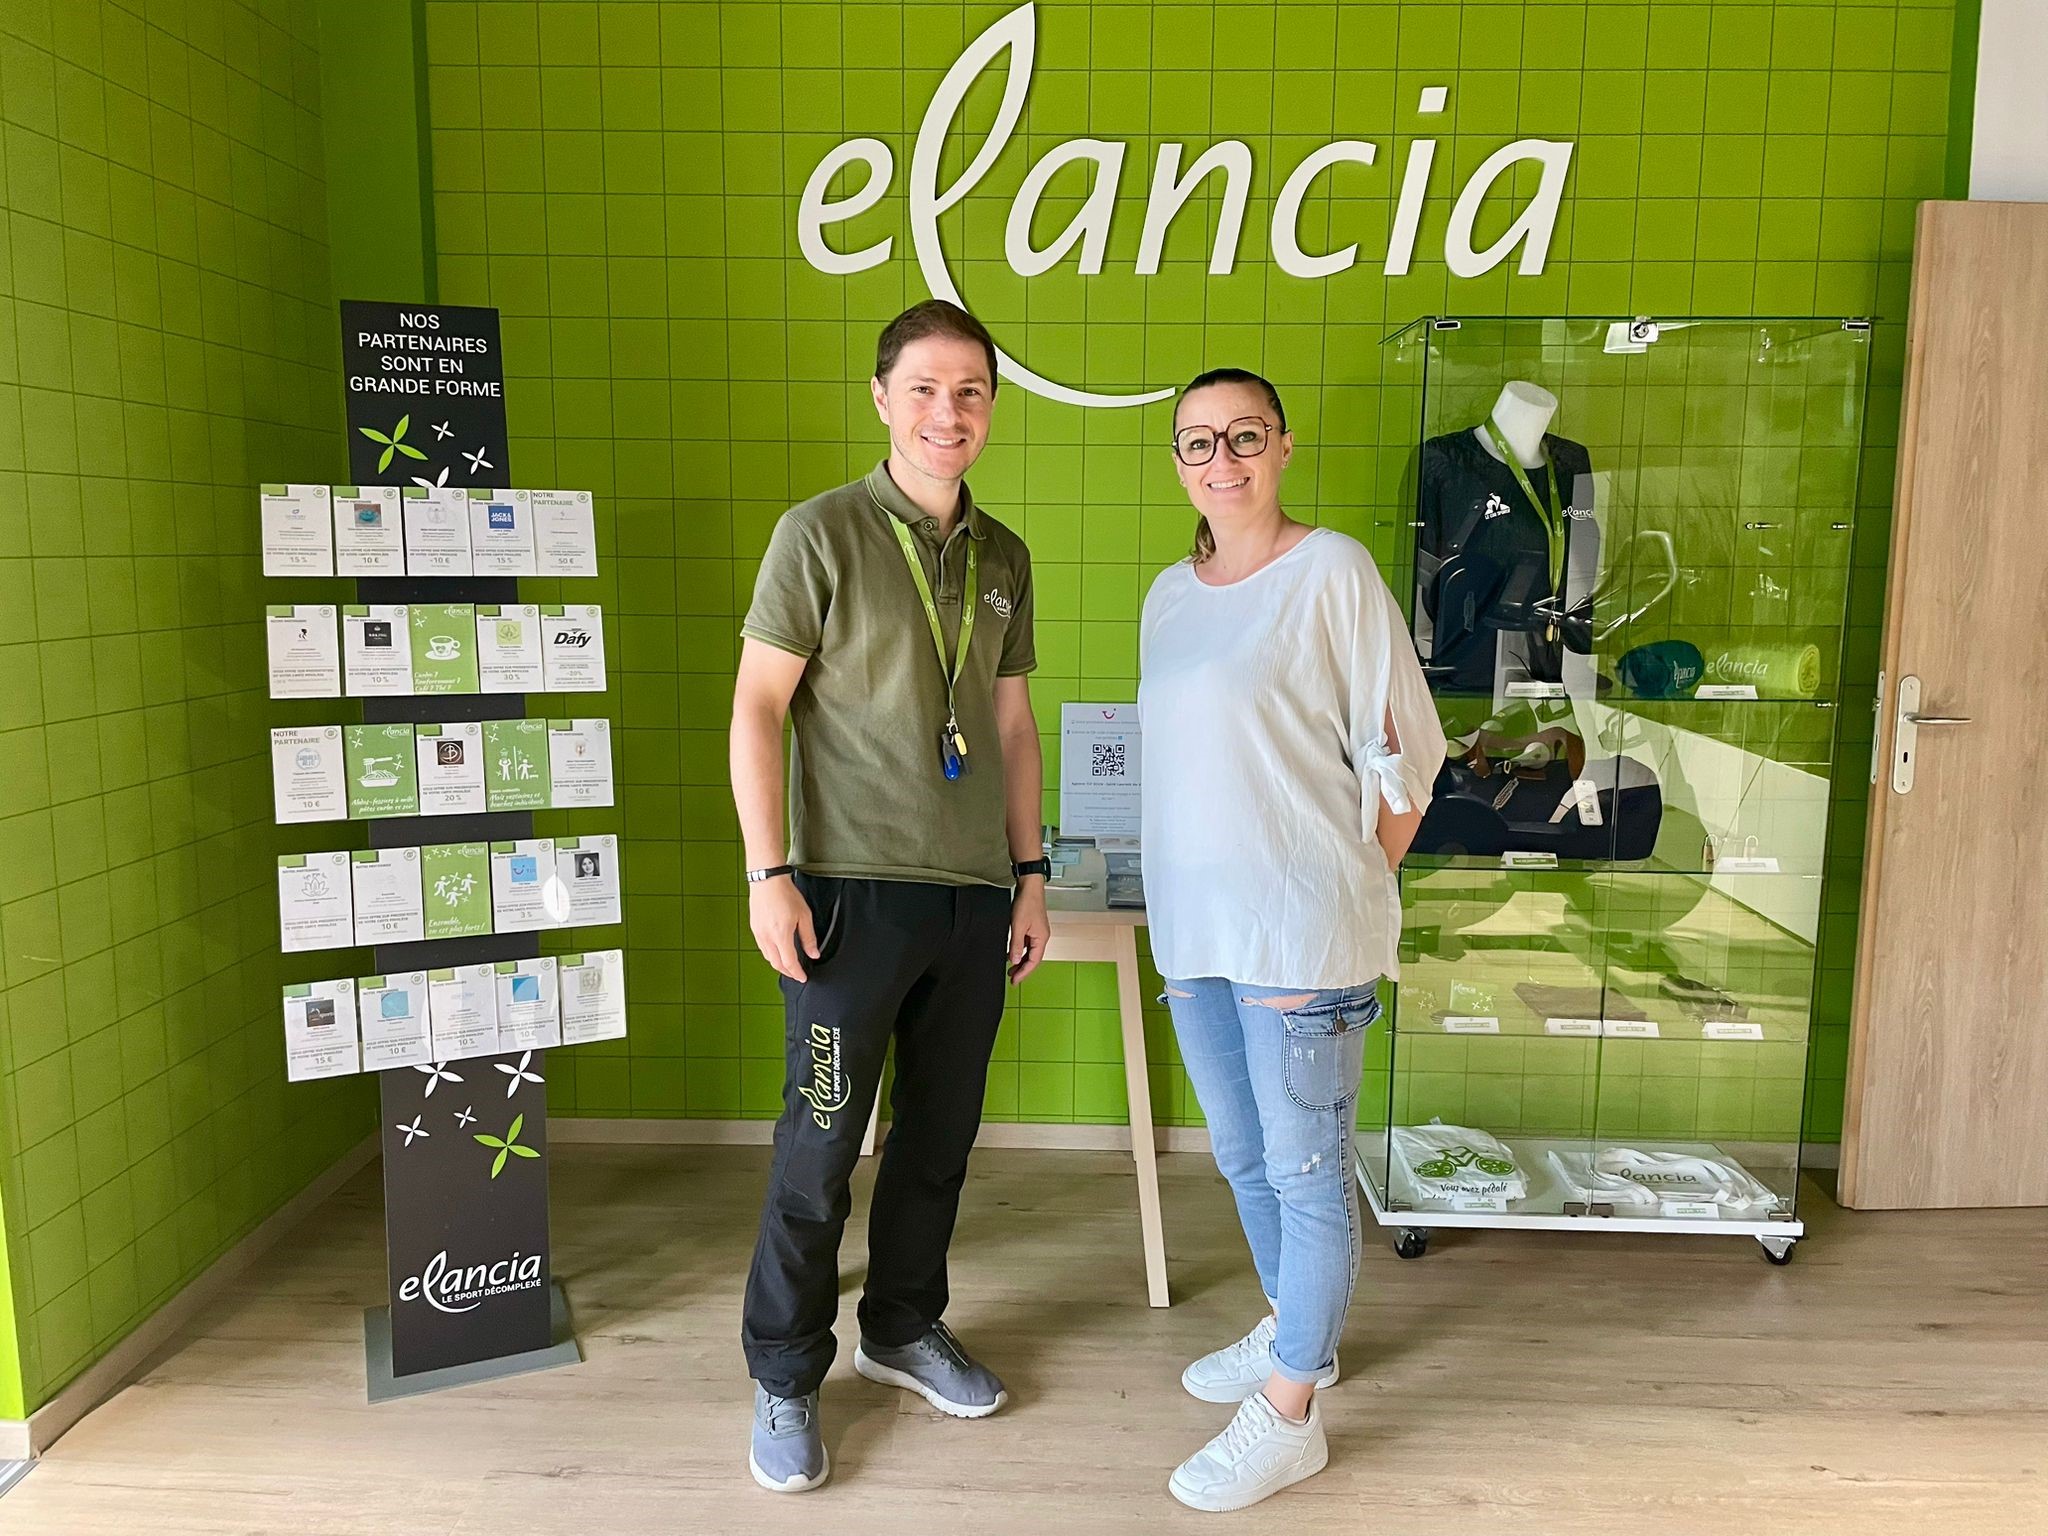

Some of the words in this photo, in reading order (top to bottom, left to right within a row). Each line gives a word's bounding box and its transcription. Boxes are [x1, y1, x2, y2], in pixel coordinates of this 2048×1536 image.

[798, 1, 1575, 408] elancia
[400, 313, 441, 330] NOS
[358, 332, 488, 354] PARTENAIRES
[381, 355, 433, 373] SONT
[438, 358, 464, 374] EN
[350, 376, 430, 395] GRANDE
[435, 380, 501, 398] FORME
[363, 556, 372, 564] 10
[983, 588, 1012, 619] elan
[553, 632, 592, 648] Dafy
[1706, 652, 1769, 683] elancia
[303, 800, 313, 808] 10
[382, 922, 392, 930] 10
[389, 1047, 399, 1055] 10
[798, 1023, 852, 1130] elancia
[1607, 1167, 1697, 1182] lancia
[1440, 1183, 1459, 1193] Vous
[399, 1250, 542, 1314] elancia
[441, 1295, 453, 1304] LE
[454, 1289, 483, 1302] SPORT
[485, 1278, 542, 1297] DÉCOMPLEXÉ
